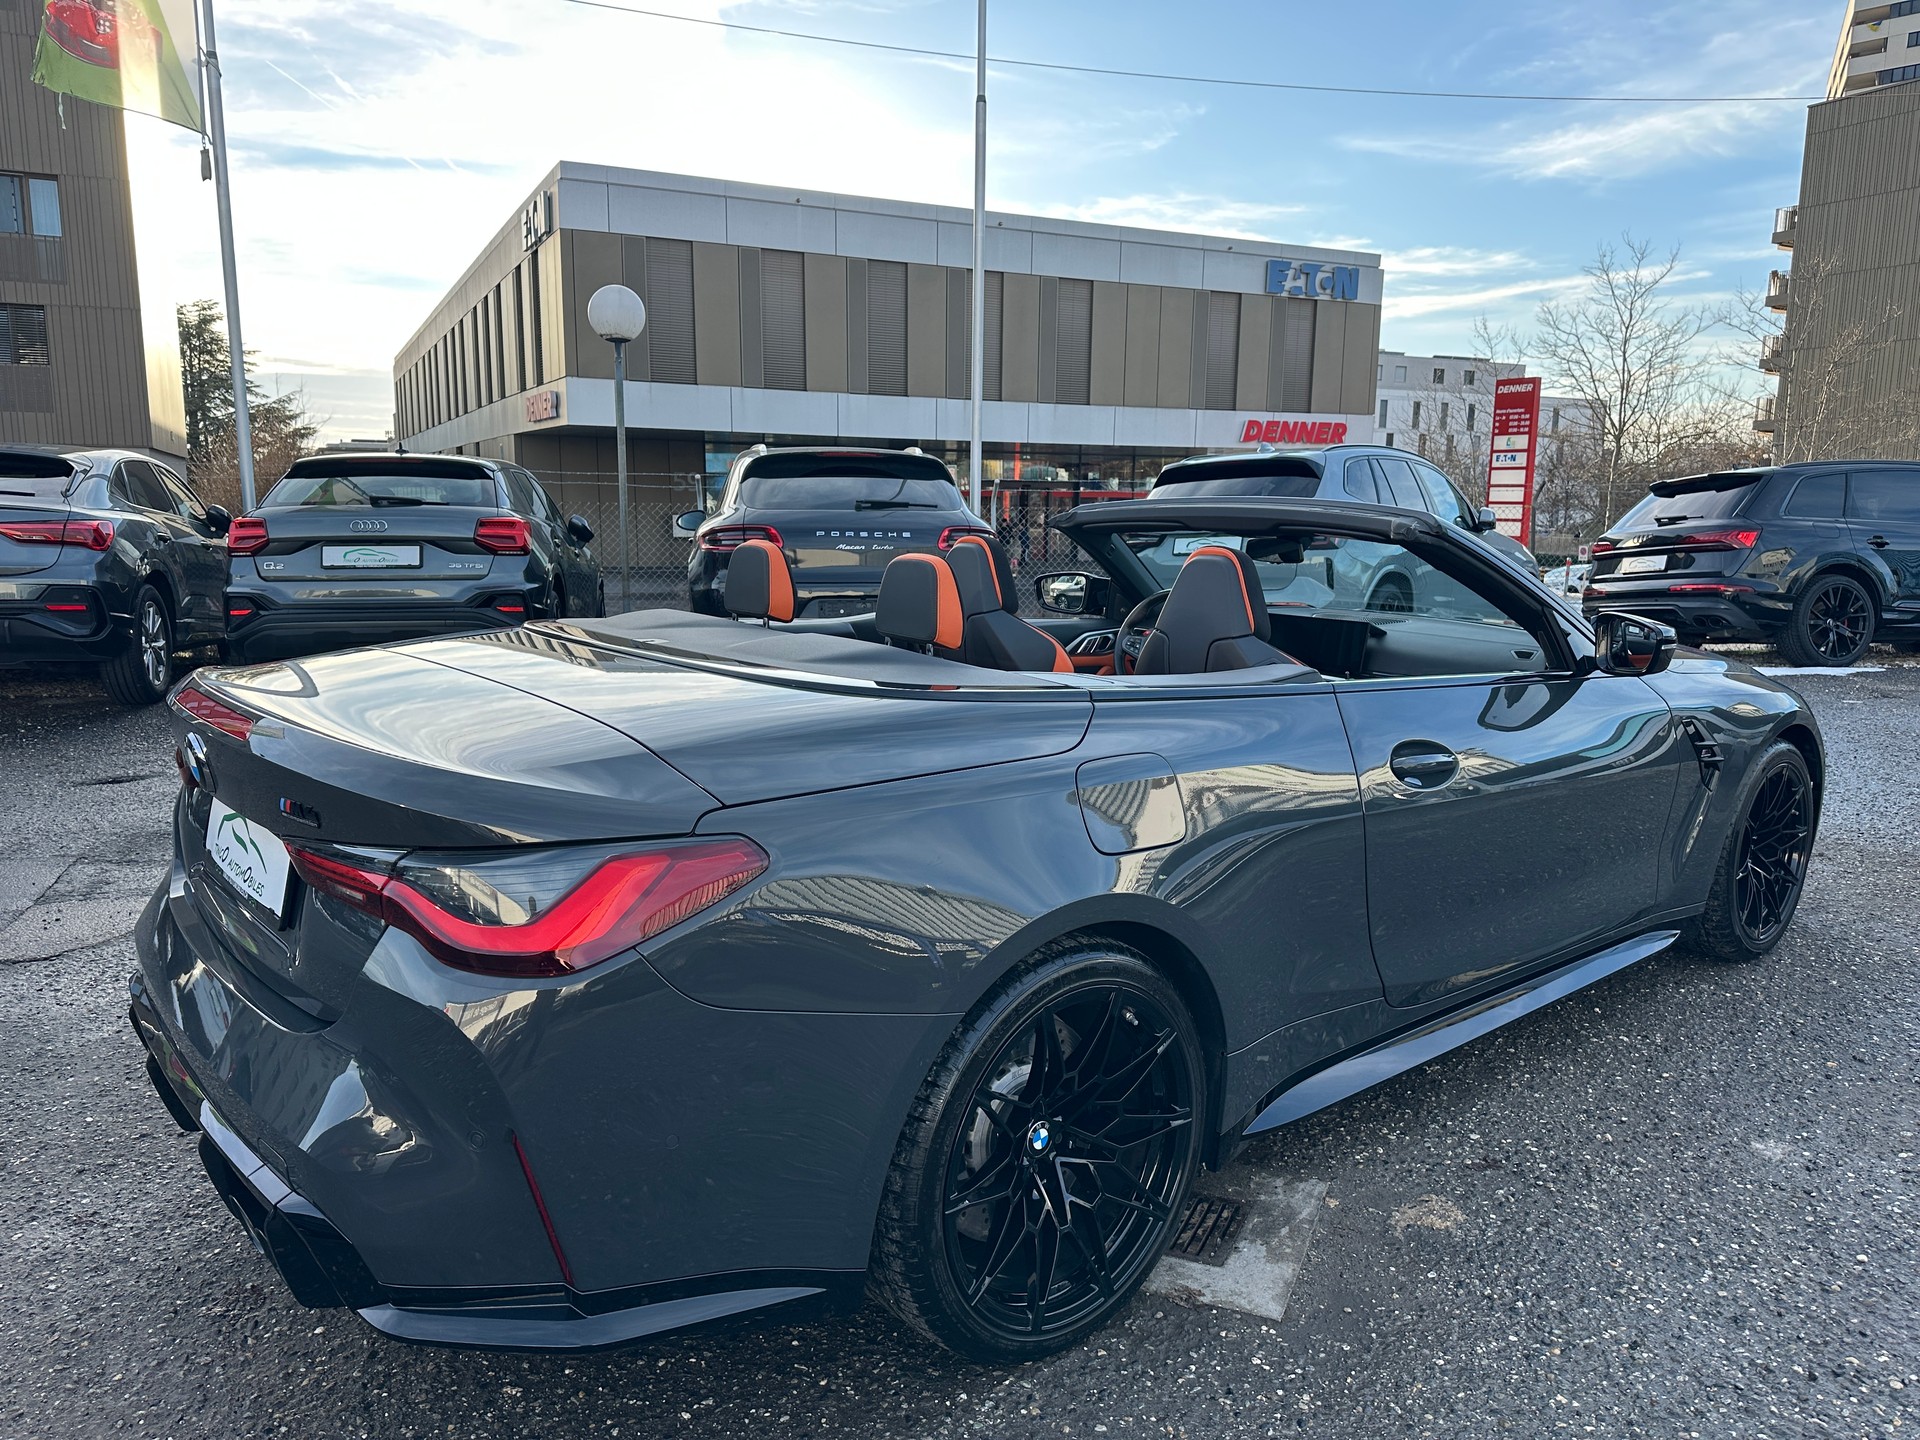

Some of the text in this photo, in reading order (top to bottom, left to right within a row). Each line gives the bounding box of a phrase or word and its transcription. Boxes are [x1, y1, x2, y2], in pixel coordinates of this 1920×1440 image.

[1265, 260, 1359, 300] EATON
[1497, 384, 1533, 394] DENNER
[1241, 419, 1348, 444] DENNER
[263, 561, 285, 570] Q2
